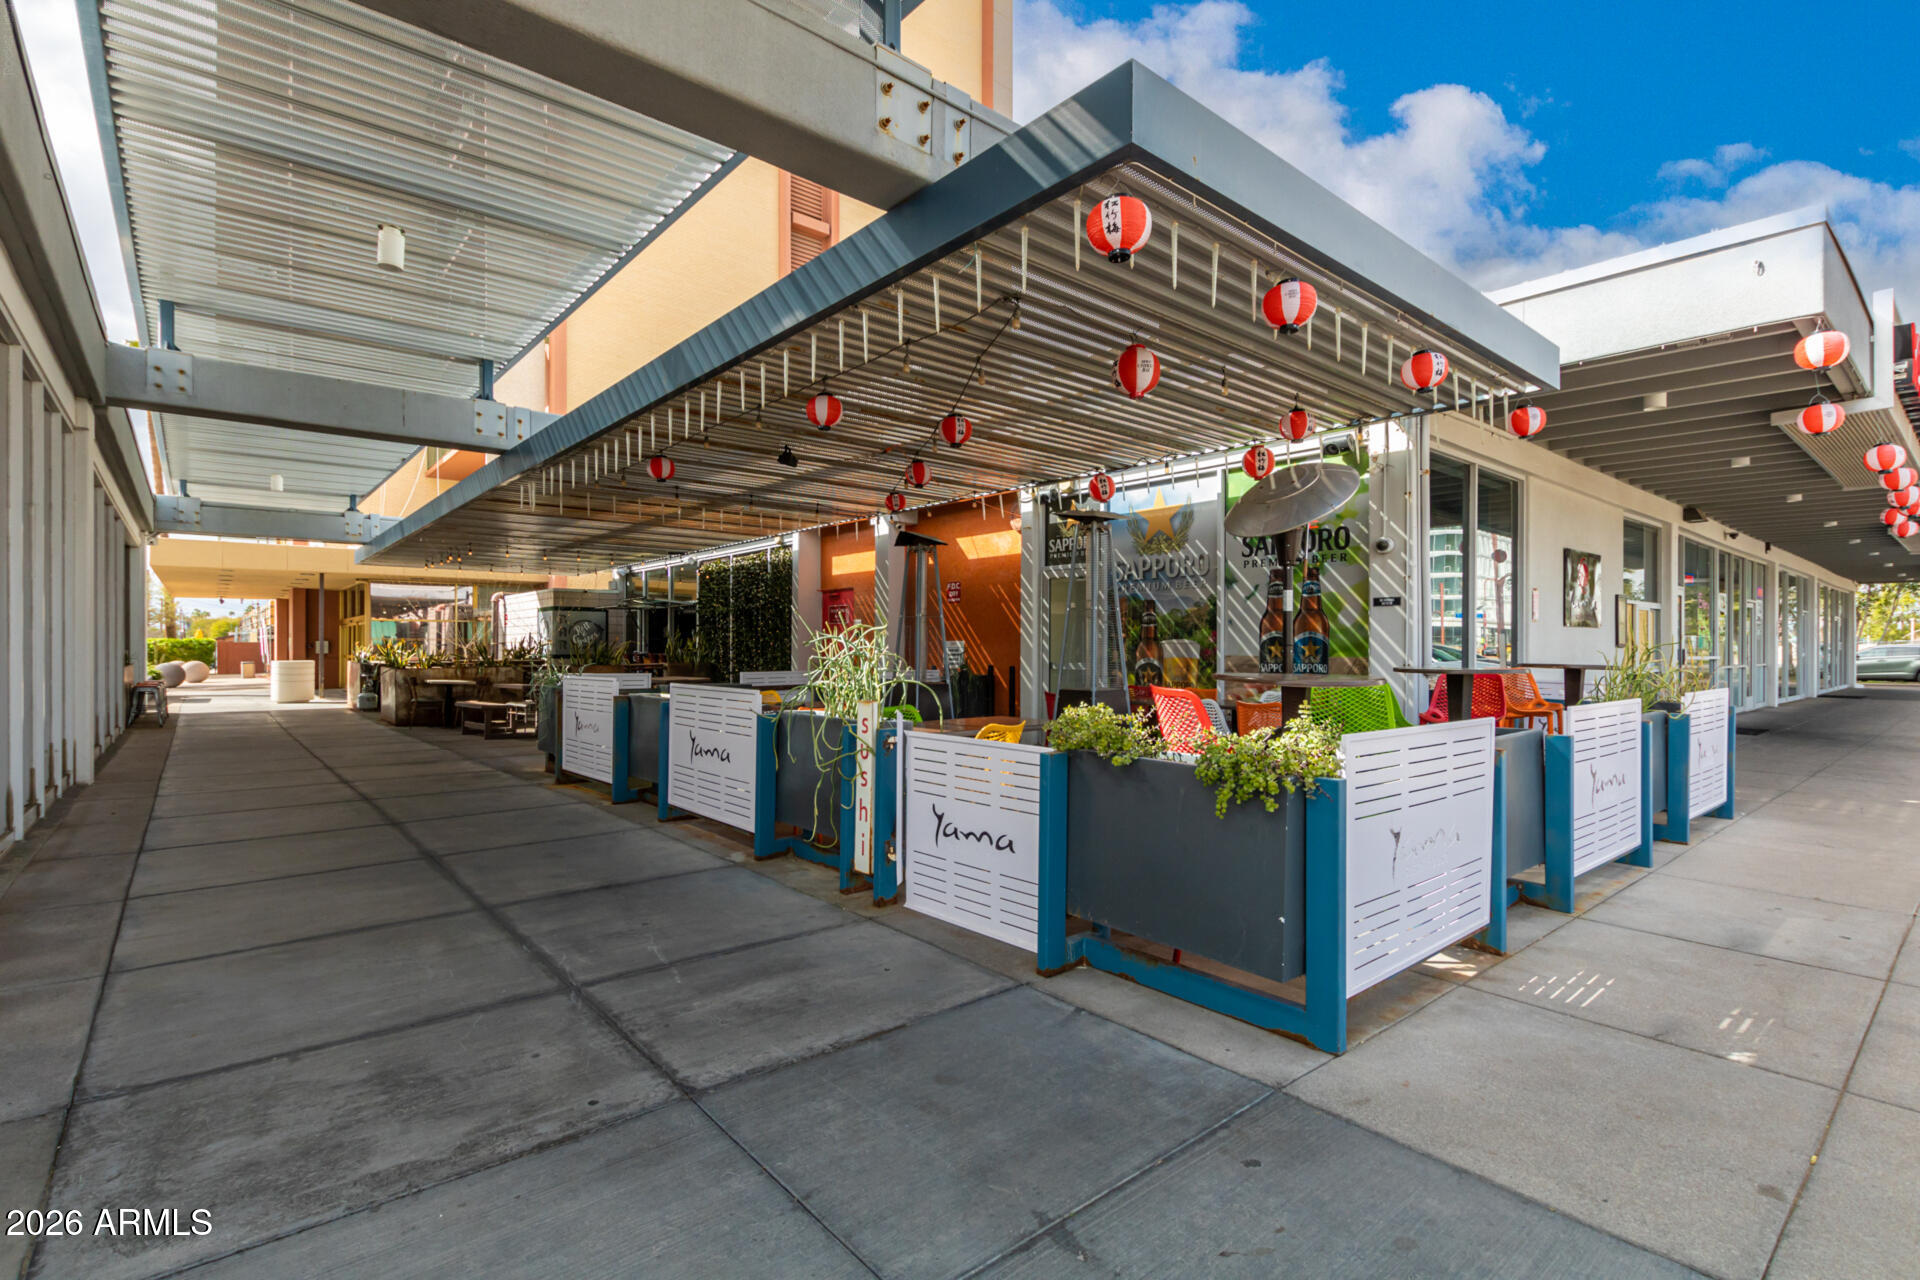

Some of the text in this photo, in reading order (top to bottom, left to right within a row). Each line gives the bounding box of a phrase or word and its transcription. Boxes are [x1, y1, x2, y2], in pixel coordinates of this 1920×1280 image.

[1103, 200, 1121, 235] 松竹梅
[1048, 535, 1087, 553] SAPPO
[1241, 526, 1351, 558] SAORO
[1312, 552, 1347, 564] BEER
[1293, 663, 1328, 673] SAPPORO
[689, 729, 731, 764] Yama
[859, 718, 869, 856] sushi
[932, 803, 1016, 854] Yama
